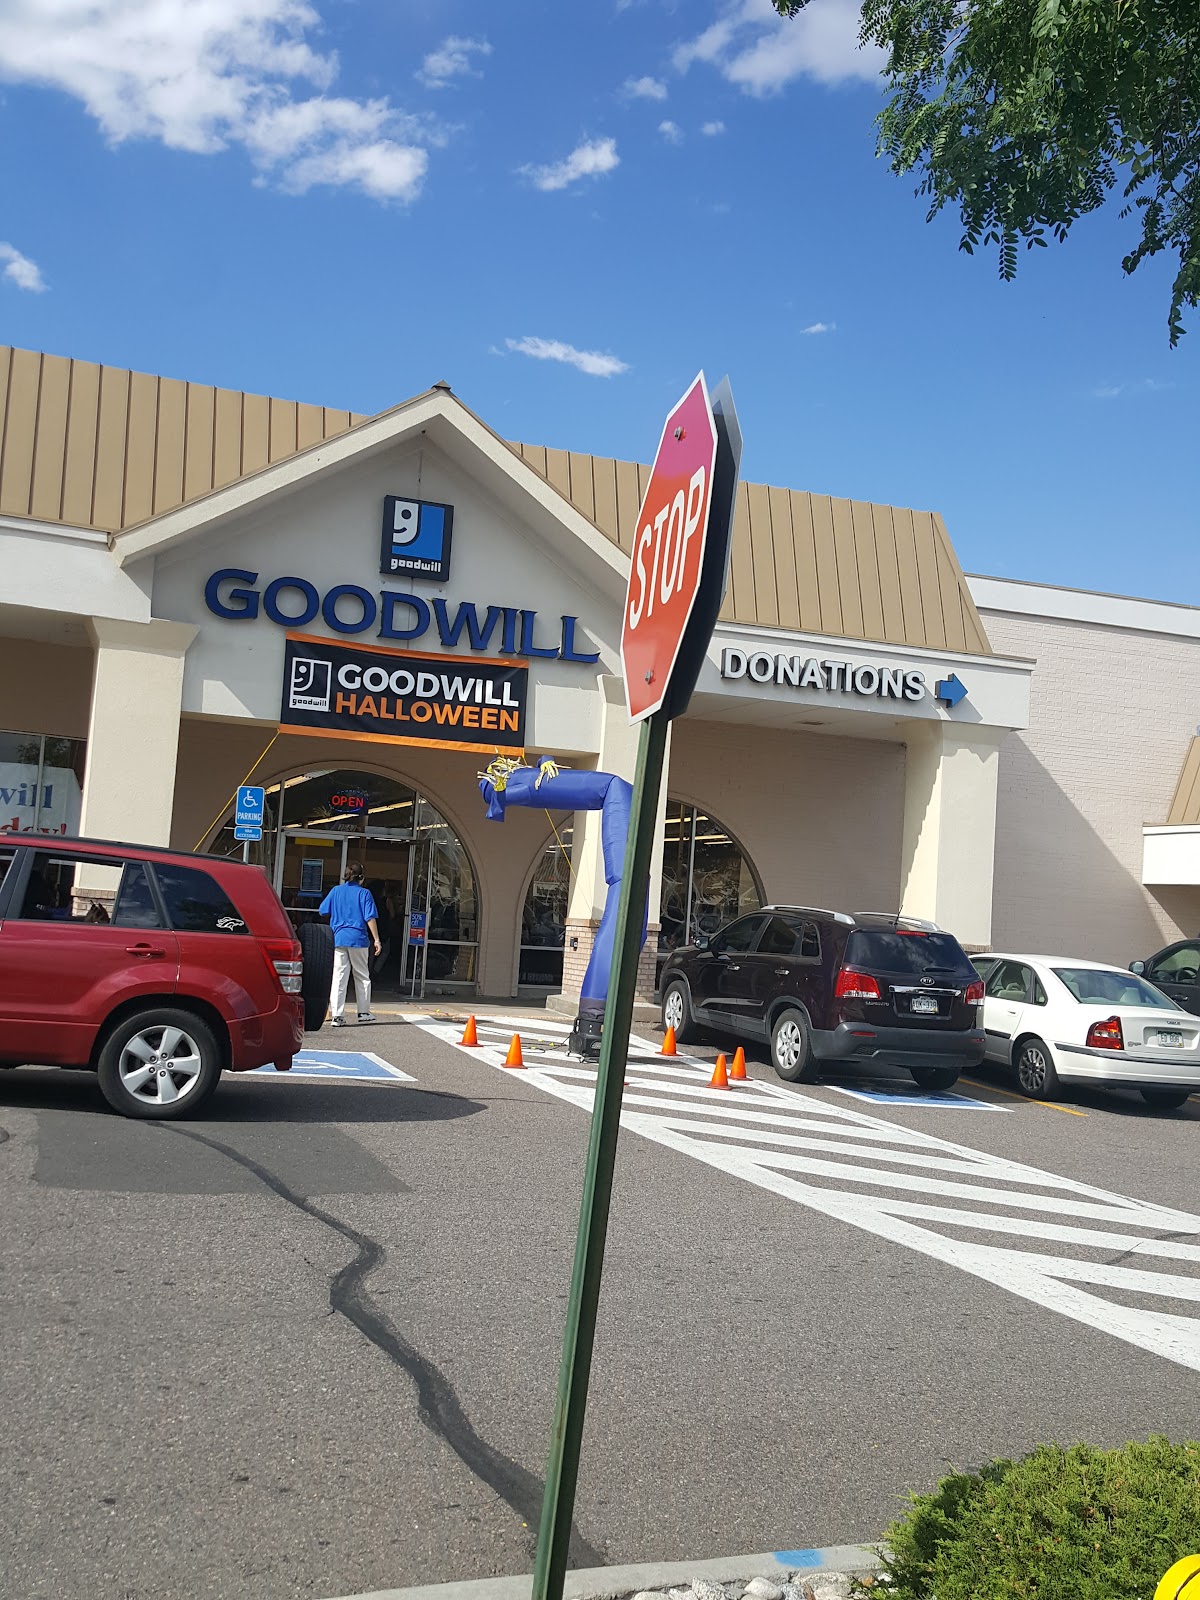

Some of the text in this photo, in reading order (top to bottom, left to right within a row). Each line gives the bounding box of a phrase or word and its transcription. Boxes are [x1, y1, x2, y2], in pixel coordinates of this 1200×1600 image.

[391, 559, 441, 572] goodwill
[629, 465, 706, 630] STOP
[204, 568, 601, 664] GOODWILL
[337, 663, 519, 707] GOODWILL
[721, 648, 926, 700] DONATIONS
[292, 698, 327, 707] goodwill
[335, 692, 519, 732] HALLOWEEN
[237, 811, 262, 821] PARKING
[331, 795, 364, 807] OPEN
